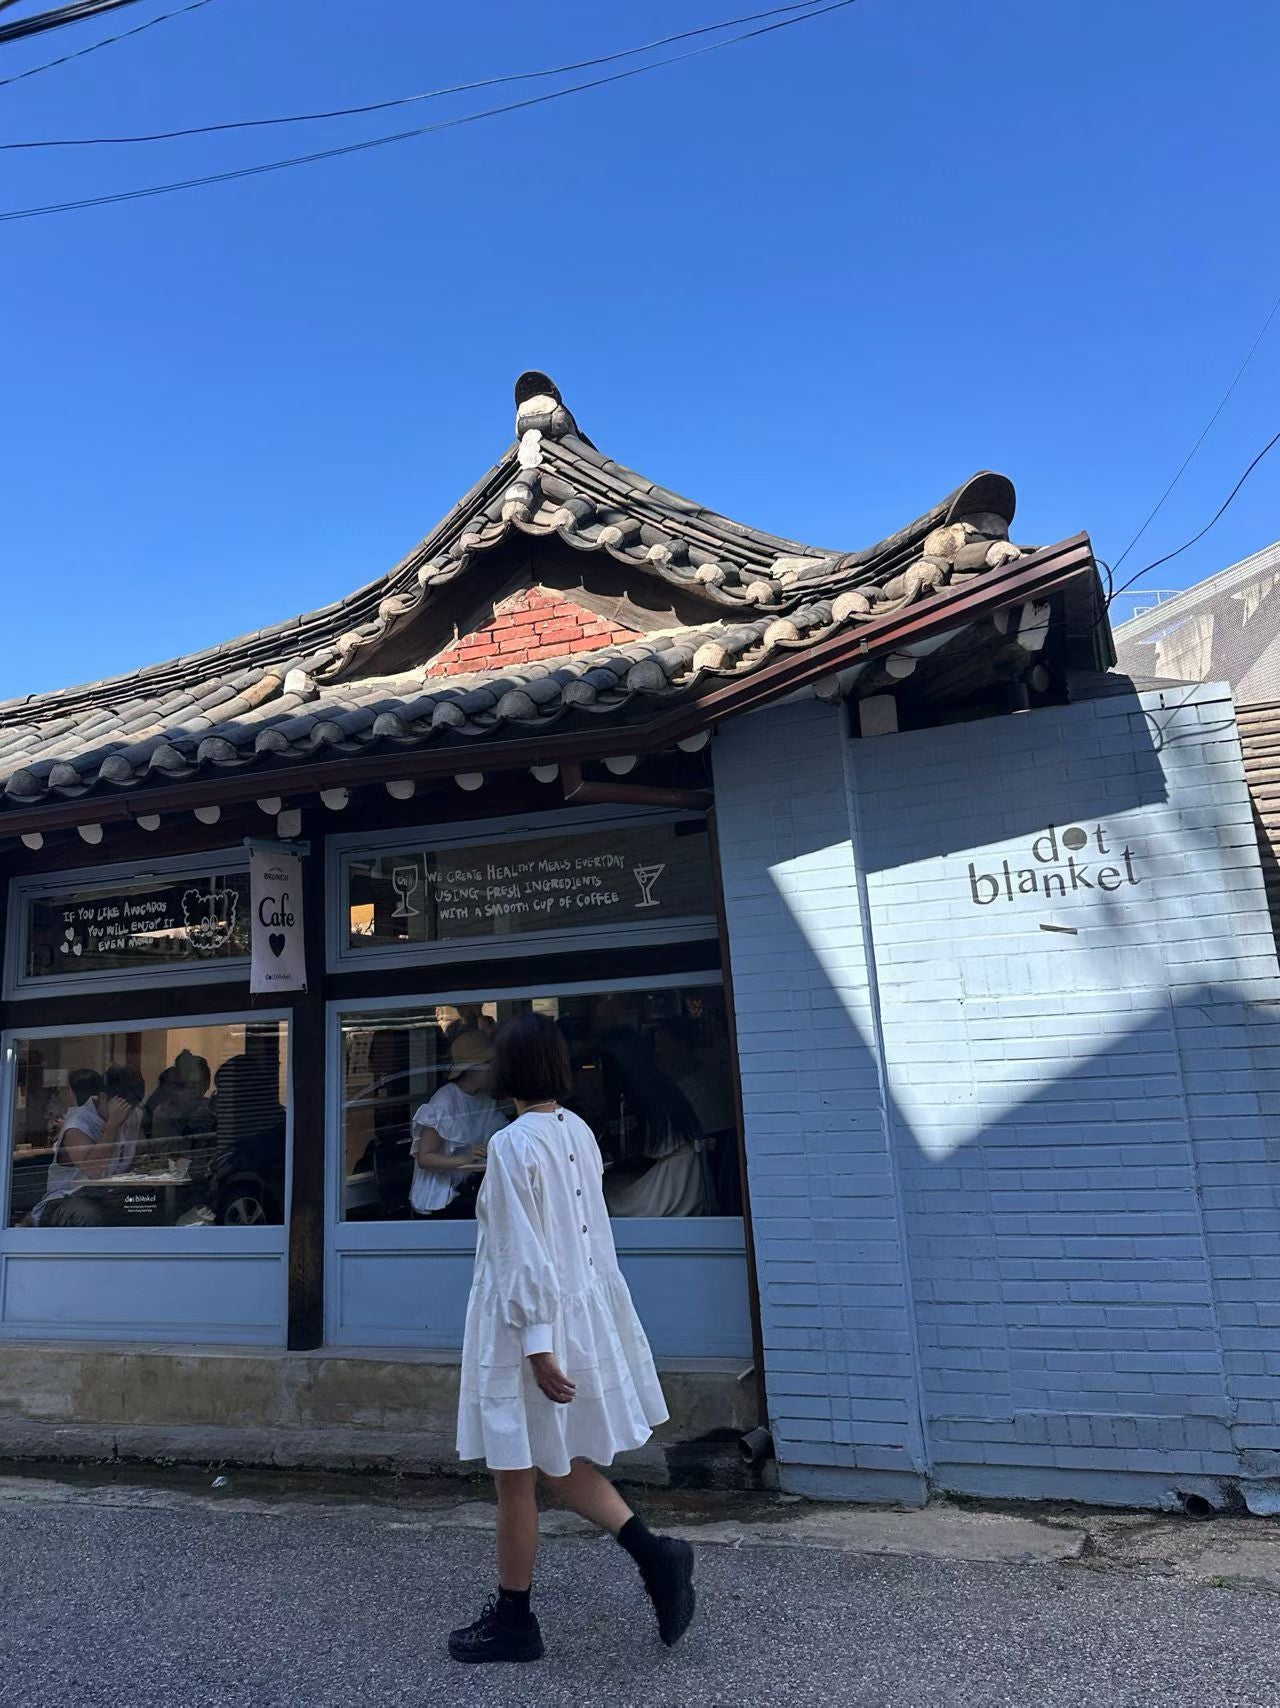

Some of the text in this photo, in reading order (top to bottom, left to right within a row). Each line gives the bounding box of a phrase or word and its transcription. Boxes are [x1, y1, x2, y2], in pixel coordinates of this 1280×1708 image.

[427, 854, 625, 883] WE CREATE HEALTHY MEALS EVERYDAY
[968, 845, 1141, 905] blanket
[434, 875, 603, 902] USING FRESH INGREDIENTS
[62, 901, 167, 924] IF YOU LIKE AVOCADOS
[258, 892, 295, 927] Cafe
[440, 892, 620, 921] WITH A SMOOTH CUP OF COFFEE
[87, 917, 175, 937] YOU WILL ENJOY IT
[98, 938, 125, 953] EVEN
